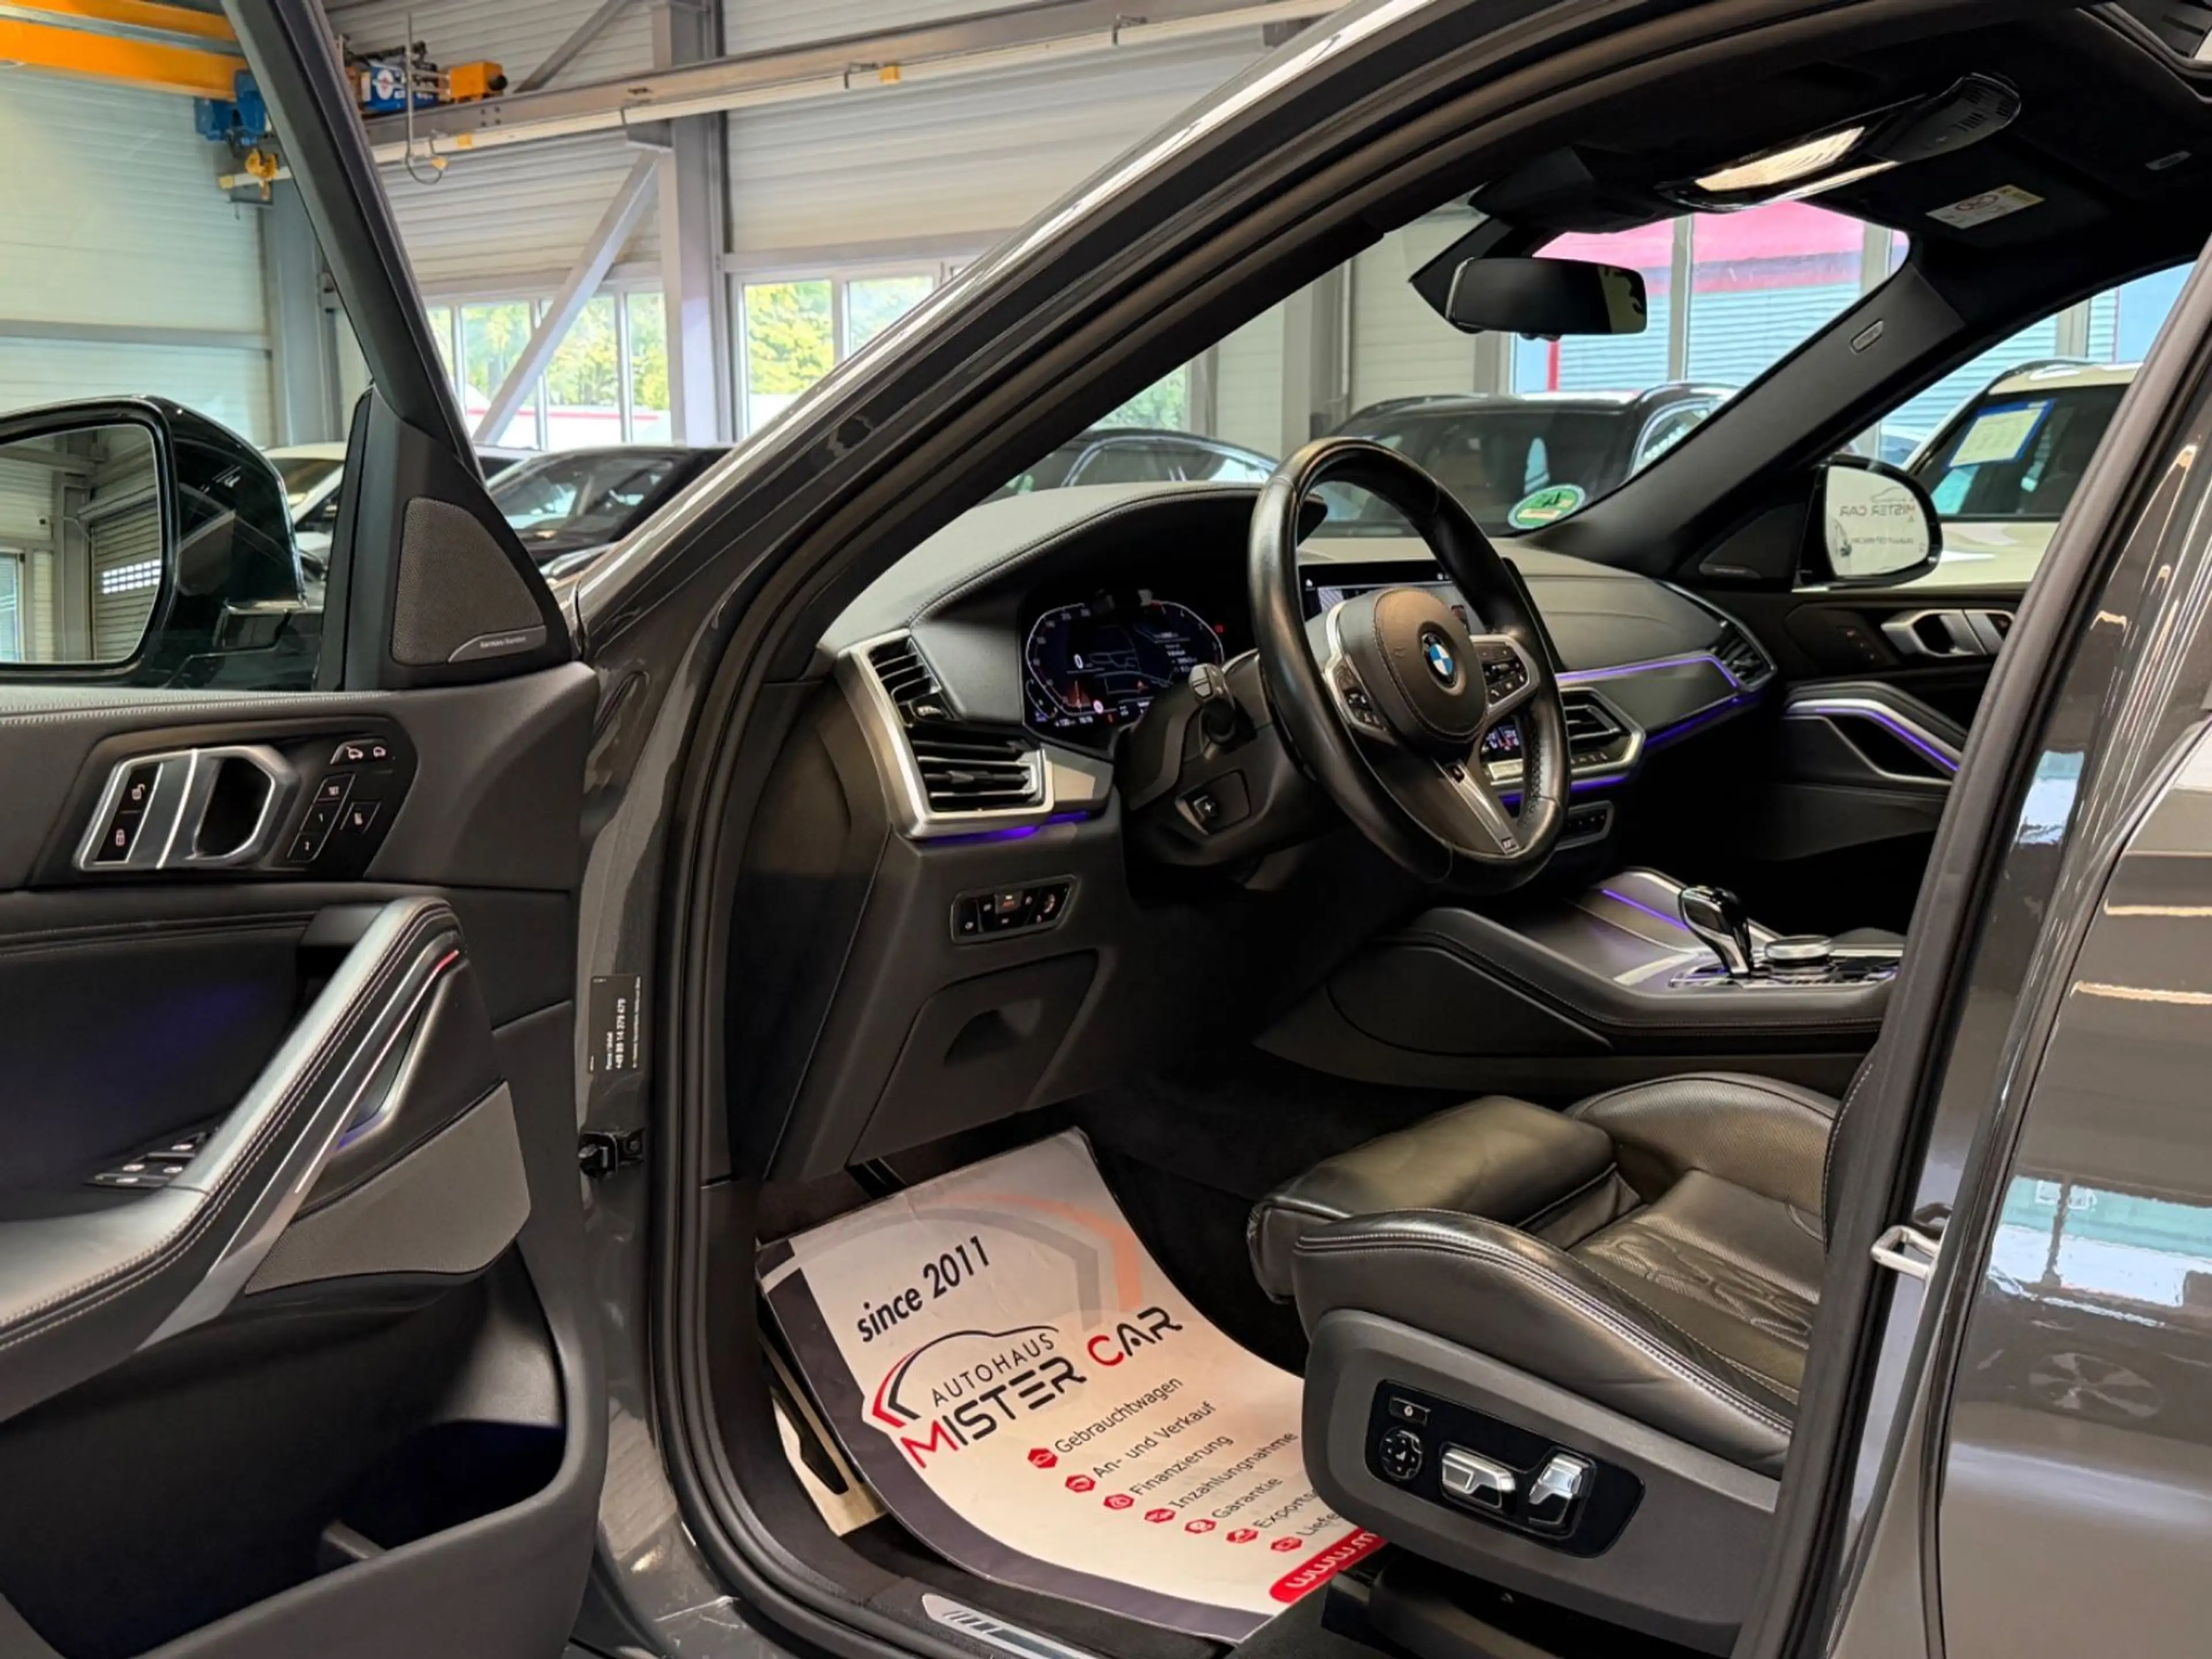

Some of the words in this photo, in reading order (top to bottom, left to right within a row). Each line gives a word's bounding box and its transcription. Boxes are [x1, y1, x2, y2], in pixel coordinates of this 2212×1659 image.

[857, 1288, 922, 1342] since
[923, 1236, 989, 1299] 2011
[900, 1357, 1087, 1469] MISTER
[1088, 1306, 1183, 1367] CAR
[931, 1332, 1055, 1407] AUTOHAUS
[1054, 1378, 1184, 1453] Gebrauchtwagen
[1092, 1459, 1123, 1479] An-
[1125, 1435, 1158, 1459] und
[1153, 1401, 1217, 1439] Verkauf
[1129, 1435, 1234, 1495] Finanzierung
[1169, 1431, 1299, 1509] Inzahlungnahme
[1211, 1476, 1283, 1519] Garantie
